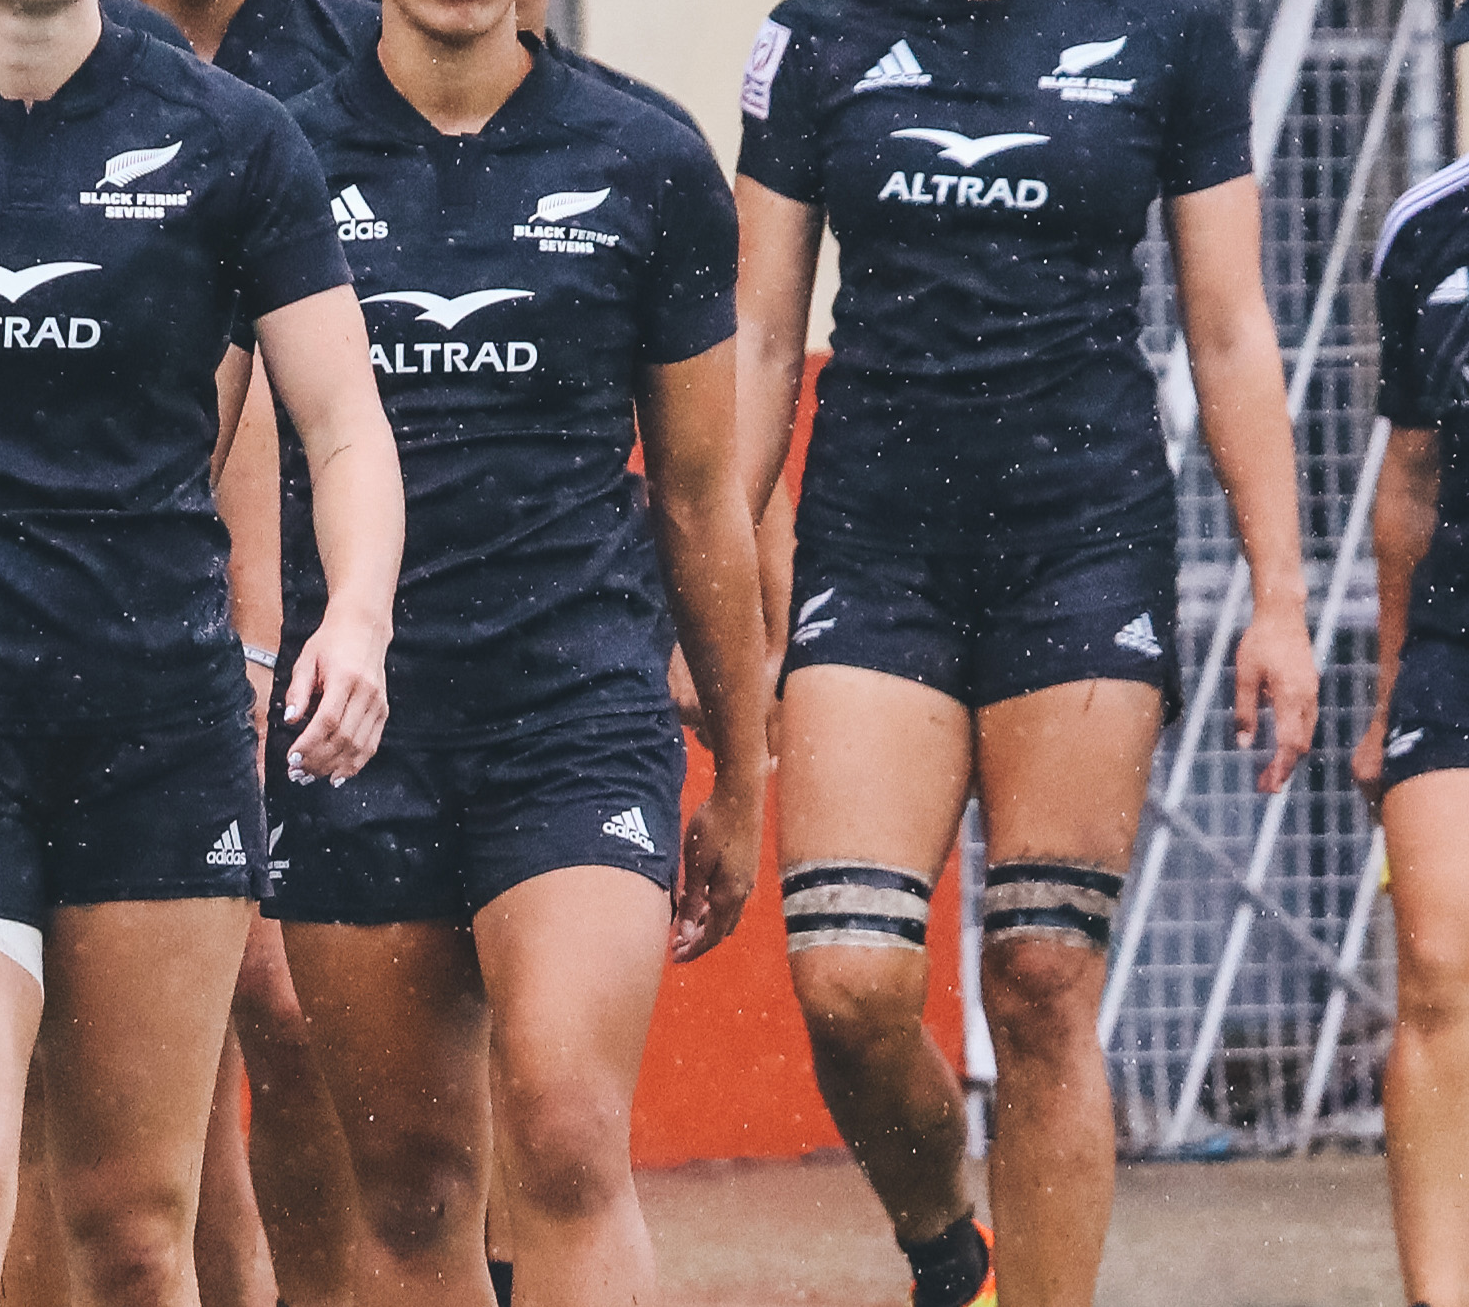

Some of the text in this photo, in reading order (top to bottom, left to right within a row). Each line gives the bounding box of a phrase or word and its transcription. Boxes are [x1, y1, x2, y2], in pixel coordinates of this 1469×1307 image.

[79, 191, 188, 206] BLACK FERNS
[878, 170, 1049, 211] ALTRAD
[105, 205, 165, 219] SEVENS
[337, 217, 389, 241] das
[513, 224, 618, 248] BLACK FERNS
[539, 239, 595, 254] SEVENS
[602, 821, 655, 854] adidas
[206, 847, 247, 866] adidas
